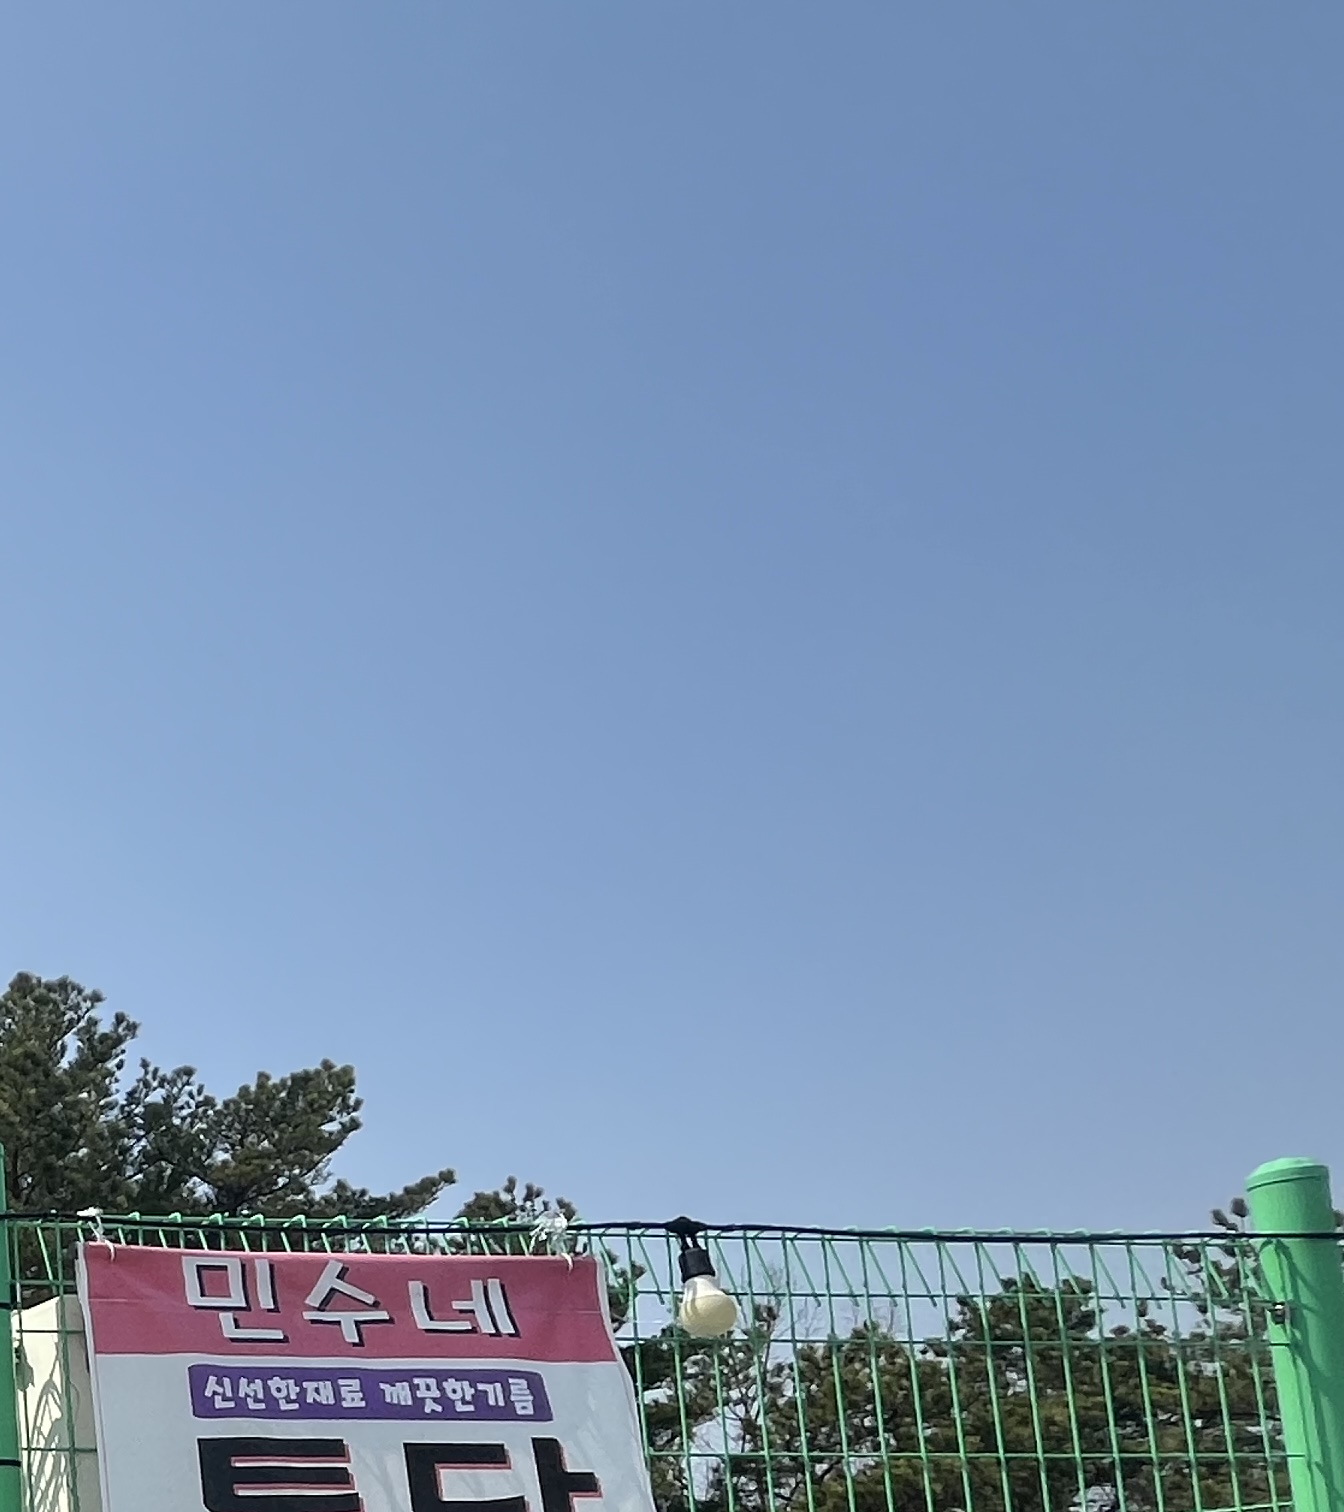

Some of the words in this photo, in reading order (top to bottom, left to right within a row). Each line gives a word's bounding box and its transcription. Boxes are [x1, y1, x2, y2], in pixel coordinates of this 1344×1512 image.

[181, 1255, 520, 1344] 민수네
[204, 1375, 367, 1411] 신선한재료
[378, 1377, 535, 1415] 깨끗한기름
